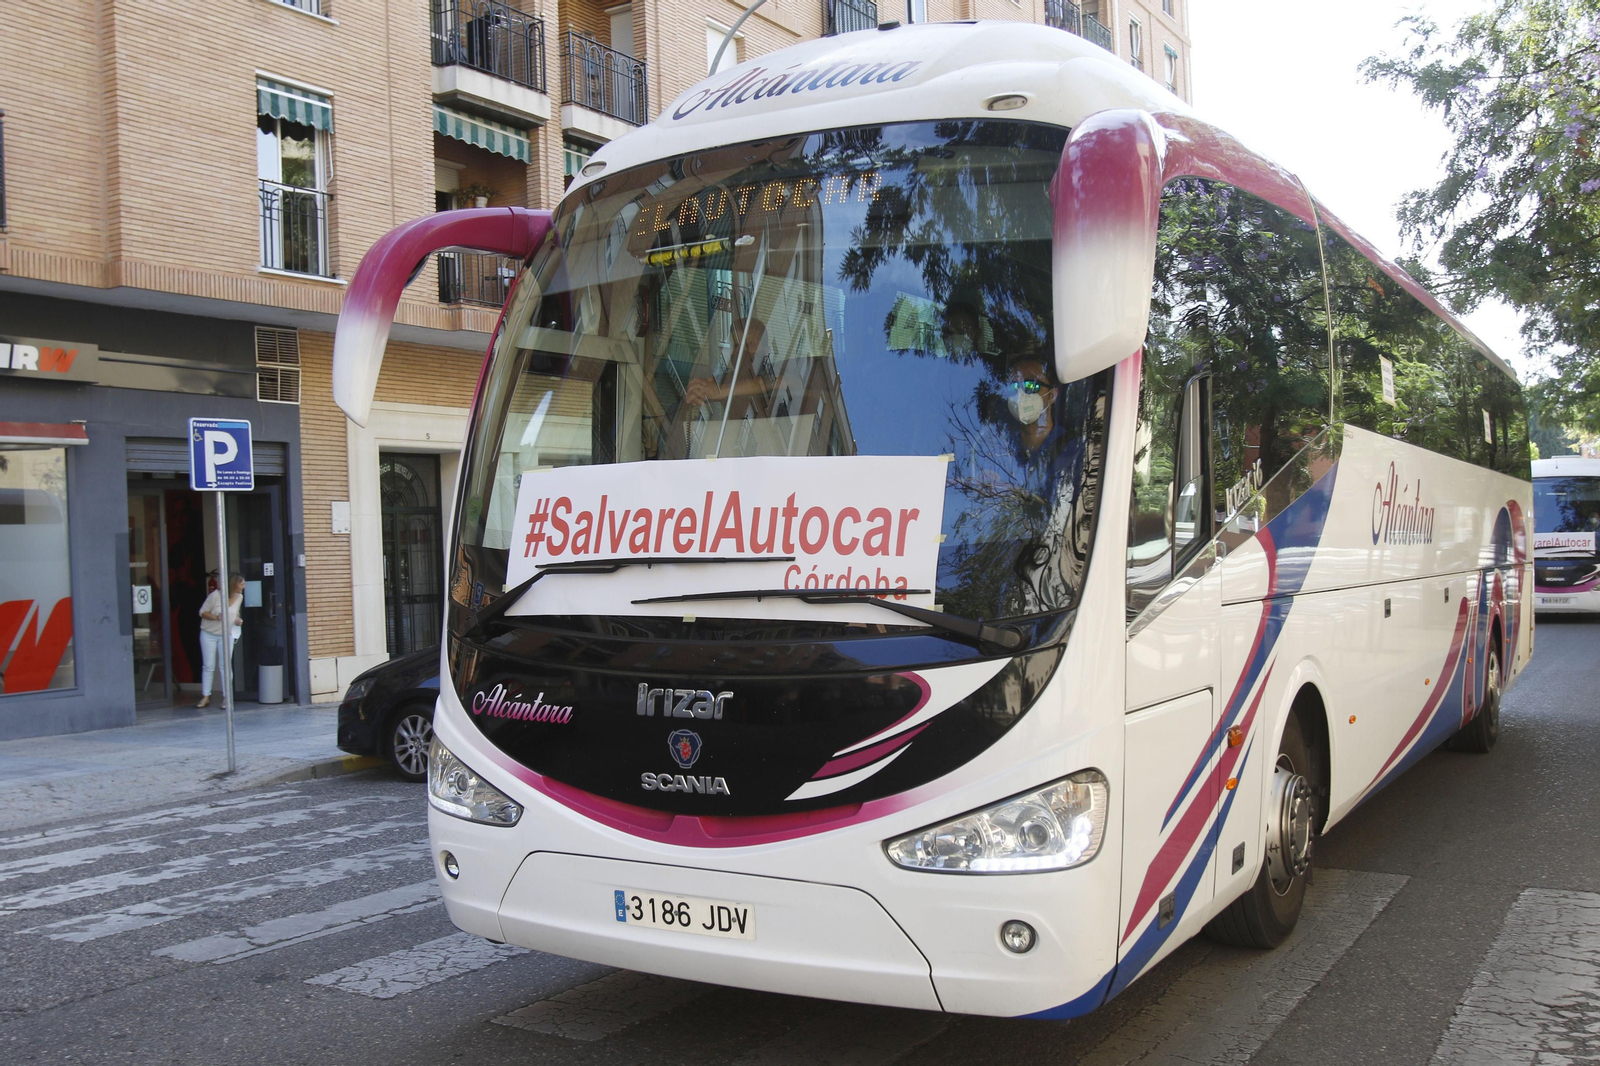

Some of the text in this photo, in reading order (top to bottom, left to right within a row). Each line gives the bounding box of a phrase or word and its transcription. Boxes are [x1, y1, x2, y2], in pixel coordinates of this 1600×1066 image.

[672, 60, 922, 121] Alcántara
[204, 431, 238, 482] P
[523, 490, 921, 559] #SalvarelAutocar
[1372, 460, 1435, 546] Alcántara
[783, 564, 909, 601] Córdoba
[472, 683, 574, 725] Alcántara
[640, 772, 731, 796] SCANIA
[630, 895, 748, 935] 3186 JDV
